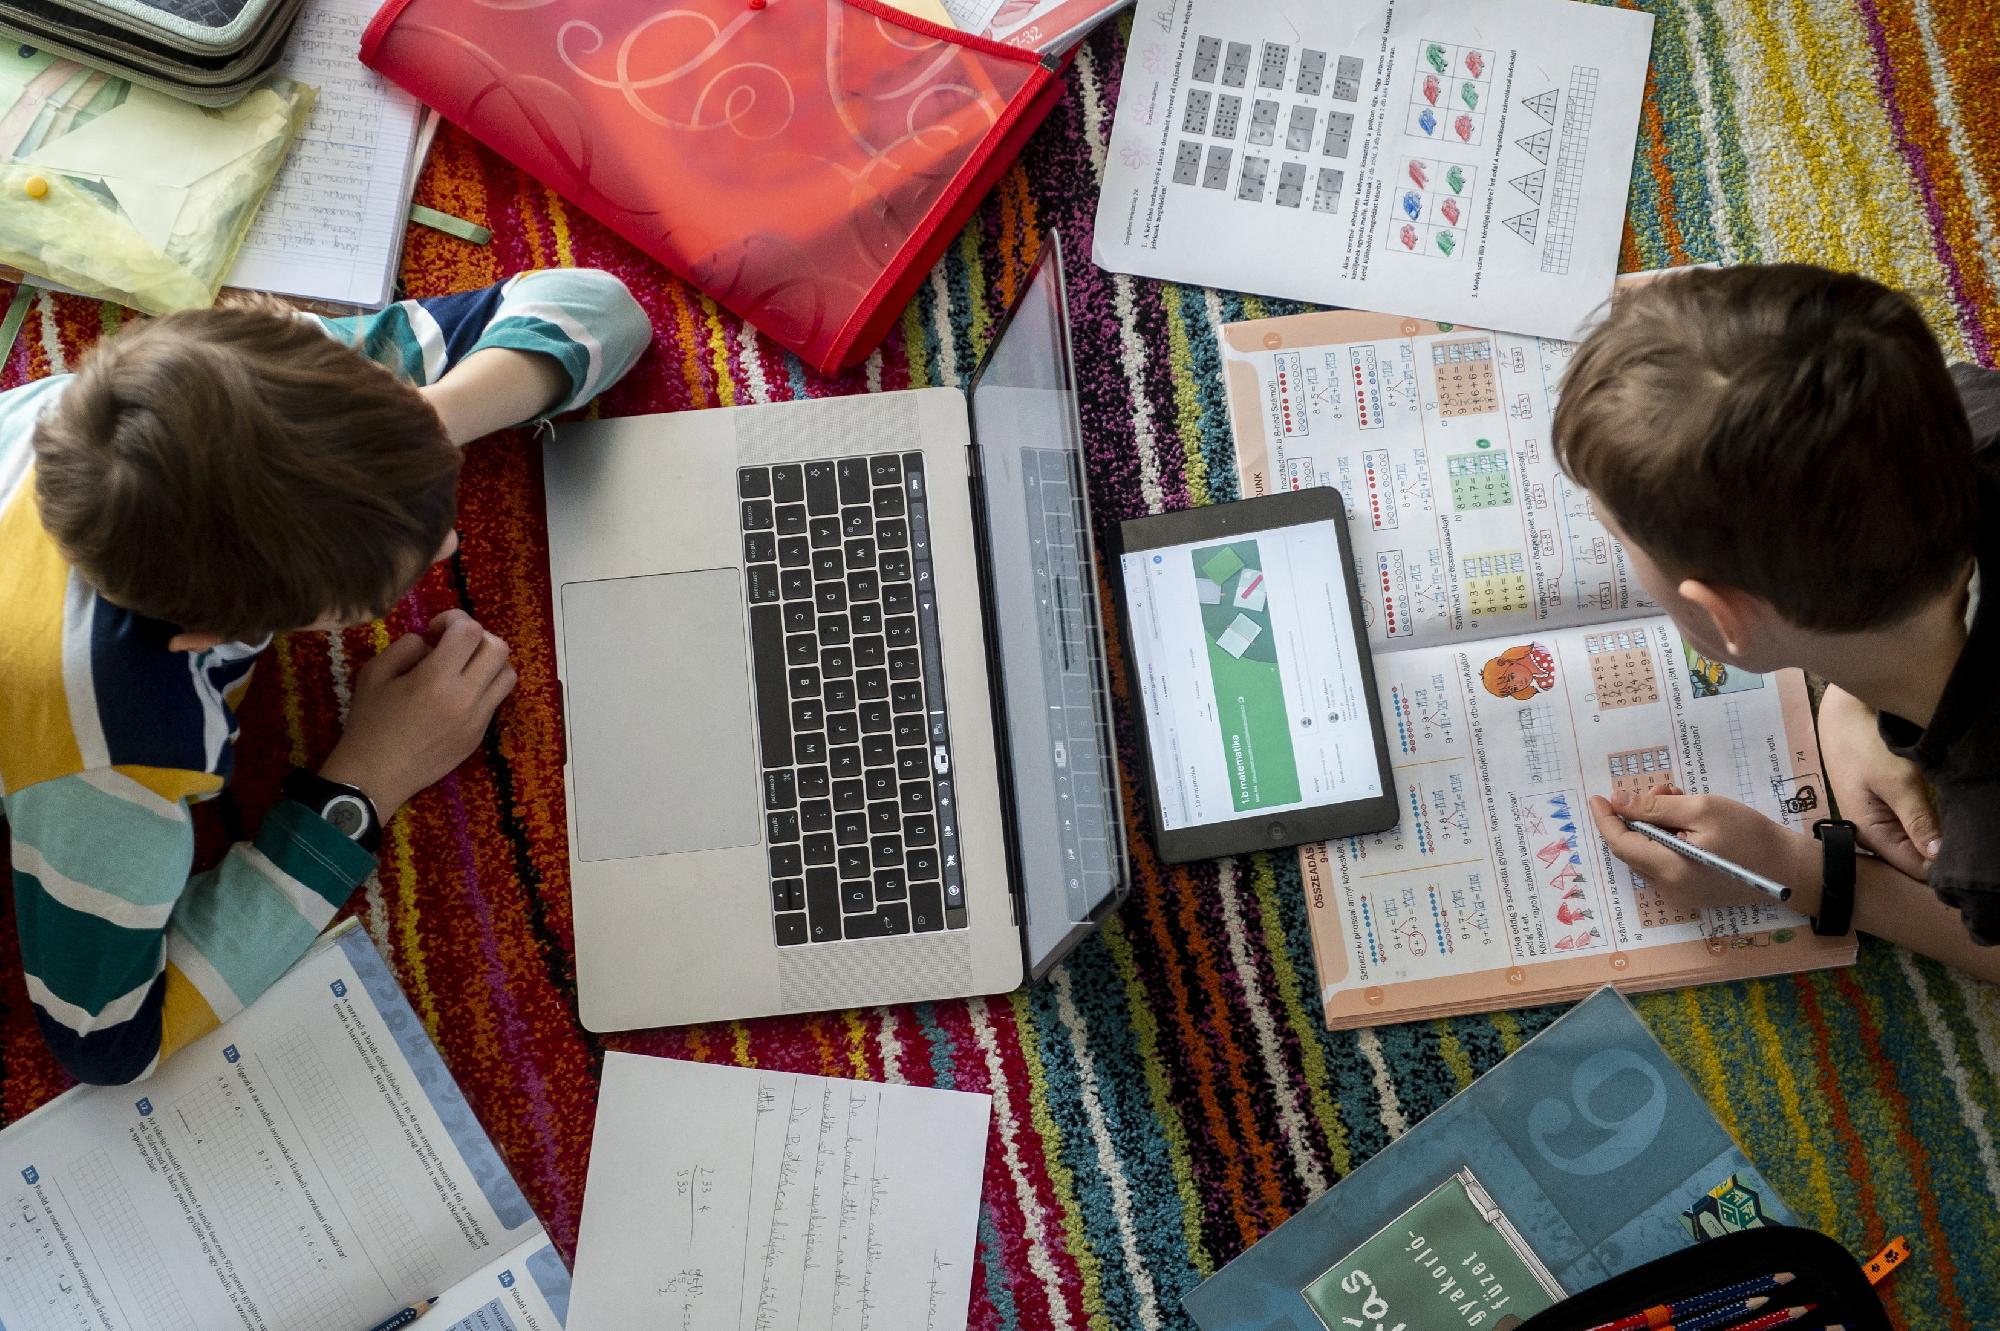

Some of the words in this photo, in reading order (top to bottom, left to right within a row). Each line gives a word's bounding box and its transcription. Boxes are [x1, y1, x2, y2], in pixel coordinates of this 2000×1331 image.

[1230, 734, 1247, 789] matematika
[1796, 750, 1805, 762] 74
[1240, 790, 1250, 804] 1.b
[1304, 845, 1324, 909] ÖSSZEADÁS
[1404, 1230, 1488, 1327] gyakorló-
[1461, 1251, 1511, 1311] füzet
